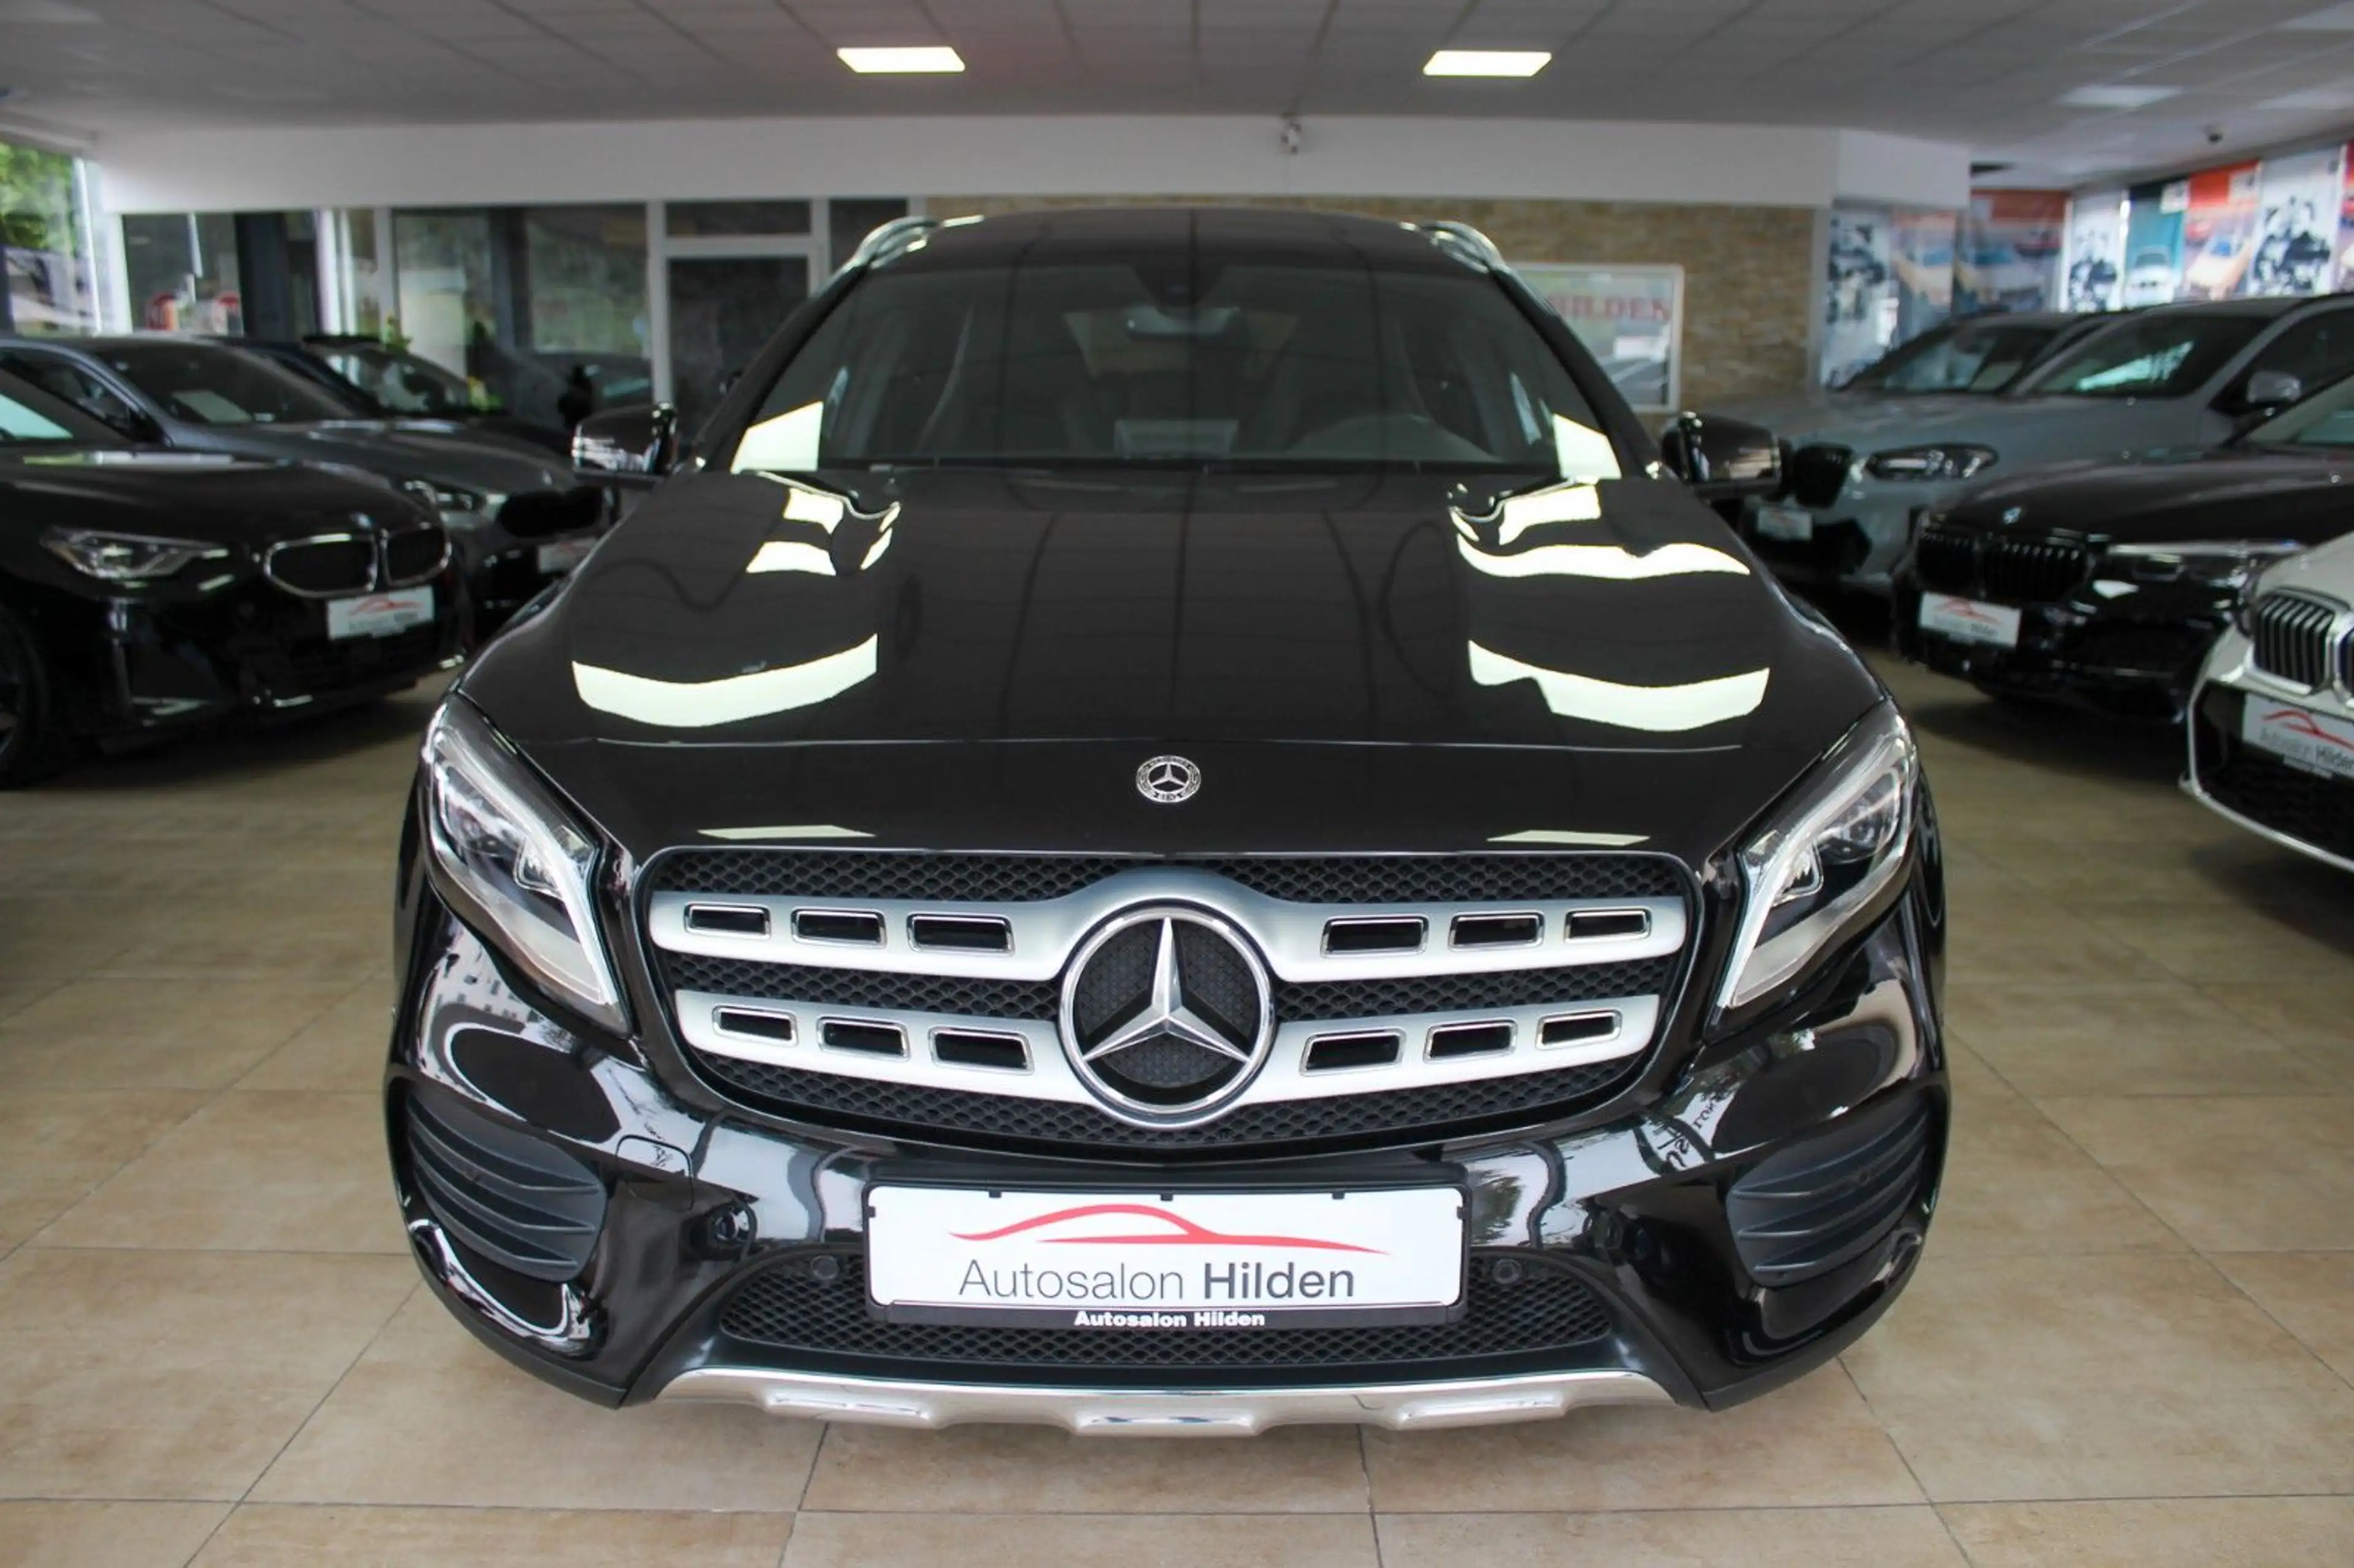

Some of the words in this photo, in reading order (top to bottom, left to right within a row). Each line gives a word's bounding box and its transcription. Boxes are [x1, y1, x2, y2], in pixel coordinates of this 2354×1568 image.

[959, 1258, 1183, 1300] Autosalon
[1204, 1261, 1354, 1299] Hilden
[1073, 1311, 1187, 1327] Autosalon
[1194, 1311, 1265, 1326] Hilden
